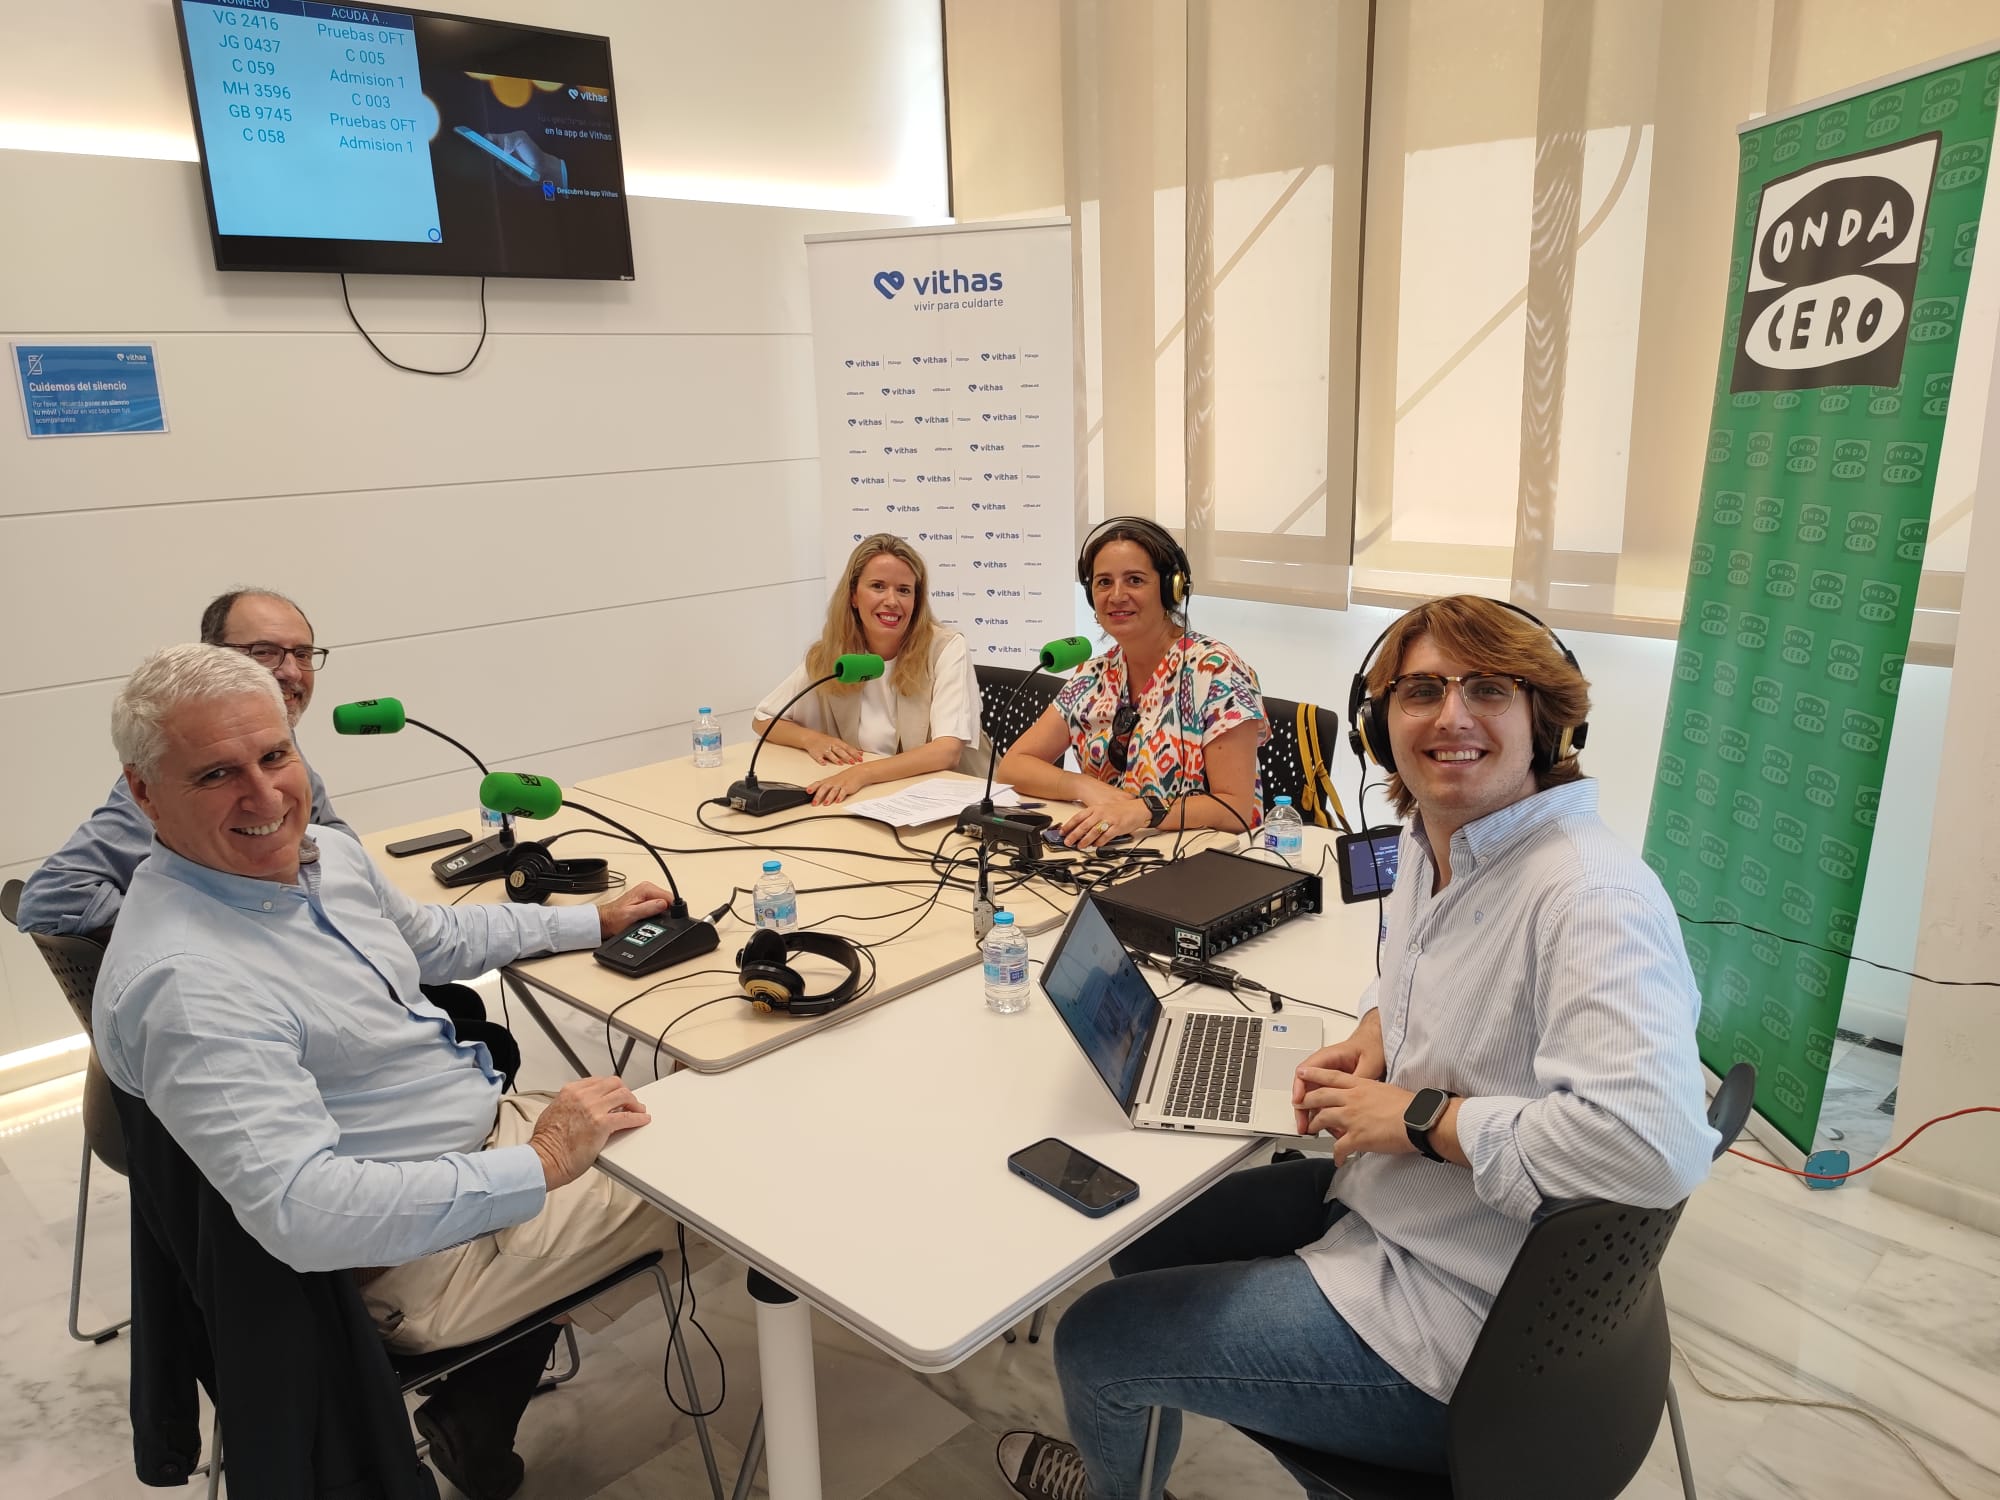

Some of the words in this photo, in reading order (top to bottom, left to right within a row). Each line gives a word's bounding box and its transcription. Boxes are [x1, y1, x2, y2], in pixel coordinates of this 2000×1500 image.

[213, 10, 236, 25] VG
[241, 13, 279, 31] 2416
[331, 8, 370, 23] ACUDA
[317, 23, 375, 42] Pruebas
[378, 31, 405, 46] OFT
[219, 35, 239, 49] JG
[245, 37, 281, 53] 0437
[345, 49, 356, 62] C
[360, 51, 385, 65] 005
[232, 59, 243, 72] C
[248, 60, 275, 75] 059
[330, 69, 393, 88] Admision
[398, 76, 405, 89] 1
[223, 81, 249, 96] MH
[254, 83, 291, 100] 3596
[351, 93, 362, 106] C
[366, 95, 391, 109] 003
[580, 92, 608, 103] vithas
[229, 104, 251, 119] GB
[255, 106, 292, 122] 9745
[329, 112, 387, 130] Pruebas
[390, 118, 416, 133] OFT
[243, 128, 253, 142] C
[257, 129, 286, 144] 058
[555, 128, 563, 136] la
[564, 129, 578, 138] app
[578, 130, 588, 138] de
[589, 131, 612, 141] Vithas
[339, 135, 403, 152] Admision
[406, 141, 413, 153] 1
[1943, 150, 1979, 166] ONDA
[1942, 170, 1976, 186] CERO
[1772, 200, 1895, 264] ONDA
[912, 268, 1003, 296] vithas
[913, 301, 935, 311] vivir
[937, 300, 960, 313] para
[961, 297, 1004, 310] cuidarte
[1915, 306, 1949, 318] ONDA
[1767, 296, 1884, 352] CERO
[1914, 325, 1946, 337] CERO
[125, 353, 147, 361] vithas
[923, 356, 947, 364] vithas
[991, 352, 1016, 361] vithas
[29, 382, 75, 392] Cuidemos
[77, 381, 91, 391] del
[92, 380, 127, 391] silencio
[892, 387, 916, 395] vithas
[979, 384, 1004, 392] vithas
[1931, 382, 1950, 391] ON
[1873, 398, 1898, 411] CERO
[1930, 398, 1947, 410] CE
[858, 418, 882, 426] vithas
[924, 416, 949, 424] vithas
[992, 413, 1017, 421] vithas
[980, 443, 1005, 451] vithas
[1792, 443, 1816, 453] ONDA
[1837, 447, 1865, 457] ONDA
[1888, 450, 1919, 461] ONDA
[1836, 464, 1862, 475] CERO
[1886, 468, 1916, 480] CERO
[927, 475, 951, 483] vithas
[994, 472, 1018, 481] vithas
[982, 503, 1006, 511] vithas
[1849, 518, 1875, 531] ONDA
[929, 533, 952, 541] vithas
[1802, 528, 1823, 539] CERO
[1904, 527, 1923, 537] ON
[1849, 537, 1873, 549] CERO
[1902, 545, 1920, 557] CE
[983, 560, 1007, 568] vithas
[1771, 568, 1794, 579] ONDA
[1769, 583, 1793, 595] CERO
[1815, 577, 1842, 590] ONDA
[997, 588, 1020, 597] vithas
[1865, 587, 1895, 600] ONDA
[1814, 594, 1839, 607] CERO
[1863, 605, 1891, 618] CERO
[985, 617, 1008, 625] vithas
[998, 645, 1022, 653] vithas
[1832, 648, 1857, 661] ONDA
[1799, 700, 1824, 714] ONDA
[1847, 716, 1875, 731] ONDA
[1846, 733, 1873, 749] CERO
[1834, 916, 1850, 928] ON
